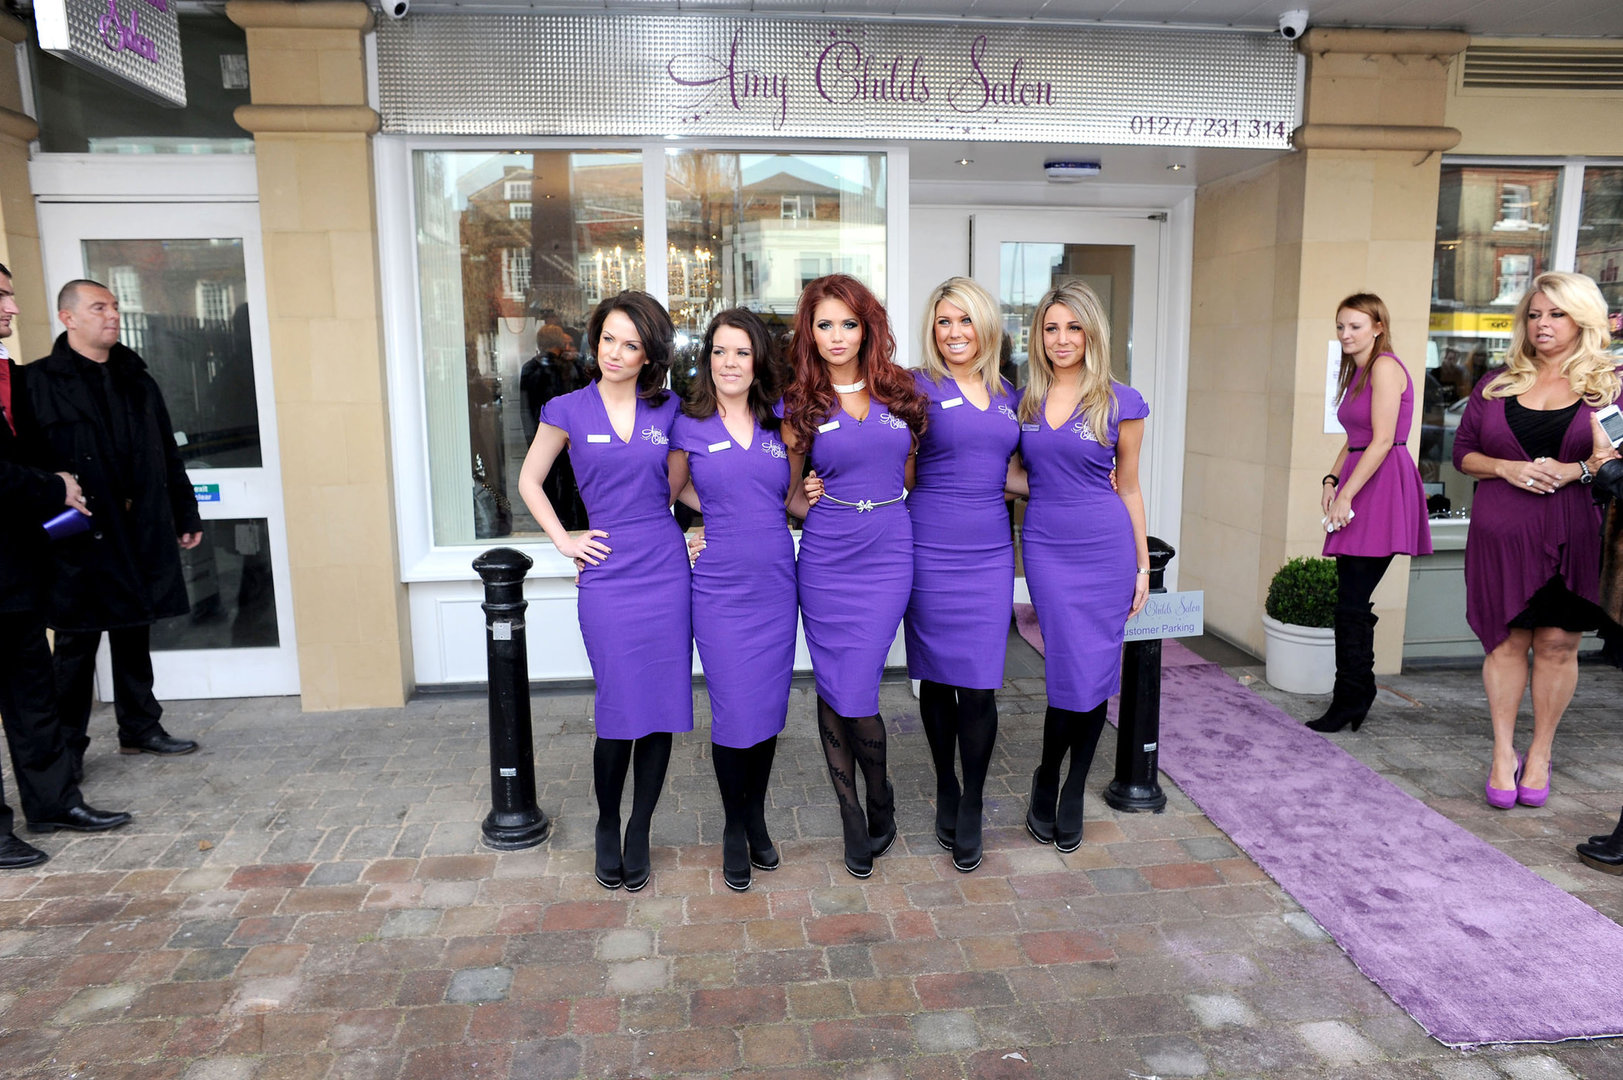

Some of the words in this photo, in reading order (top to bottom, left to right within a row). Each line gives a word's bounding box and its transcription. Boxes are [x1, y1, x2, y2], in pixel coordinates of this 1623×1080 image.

[668, 28, 788, 131] Amy
[815, 40, 931, 104] Childs
[948, 35, 1057, 113] Salon
[1130, 115, 1196, 136] 01277
[1203, 118, 1239, 137] 231
[1249, 119, 1286, 138] 314
[1123, 626, 1159, 637] ustomer
[1161, 623, 1195, 634] Parking
